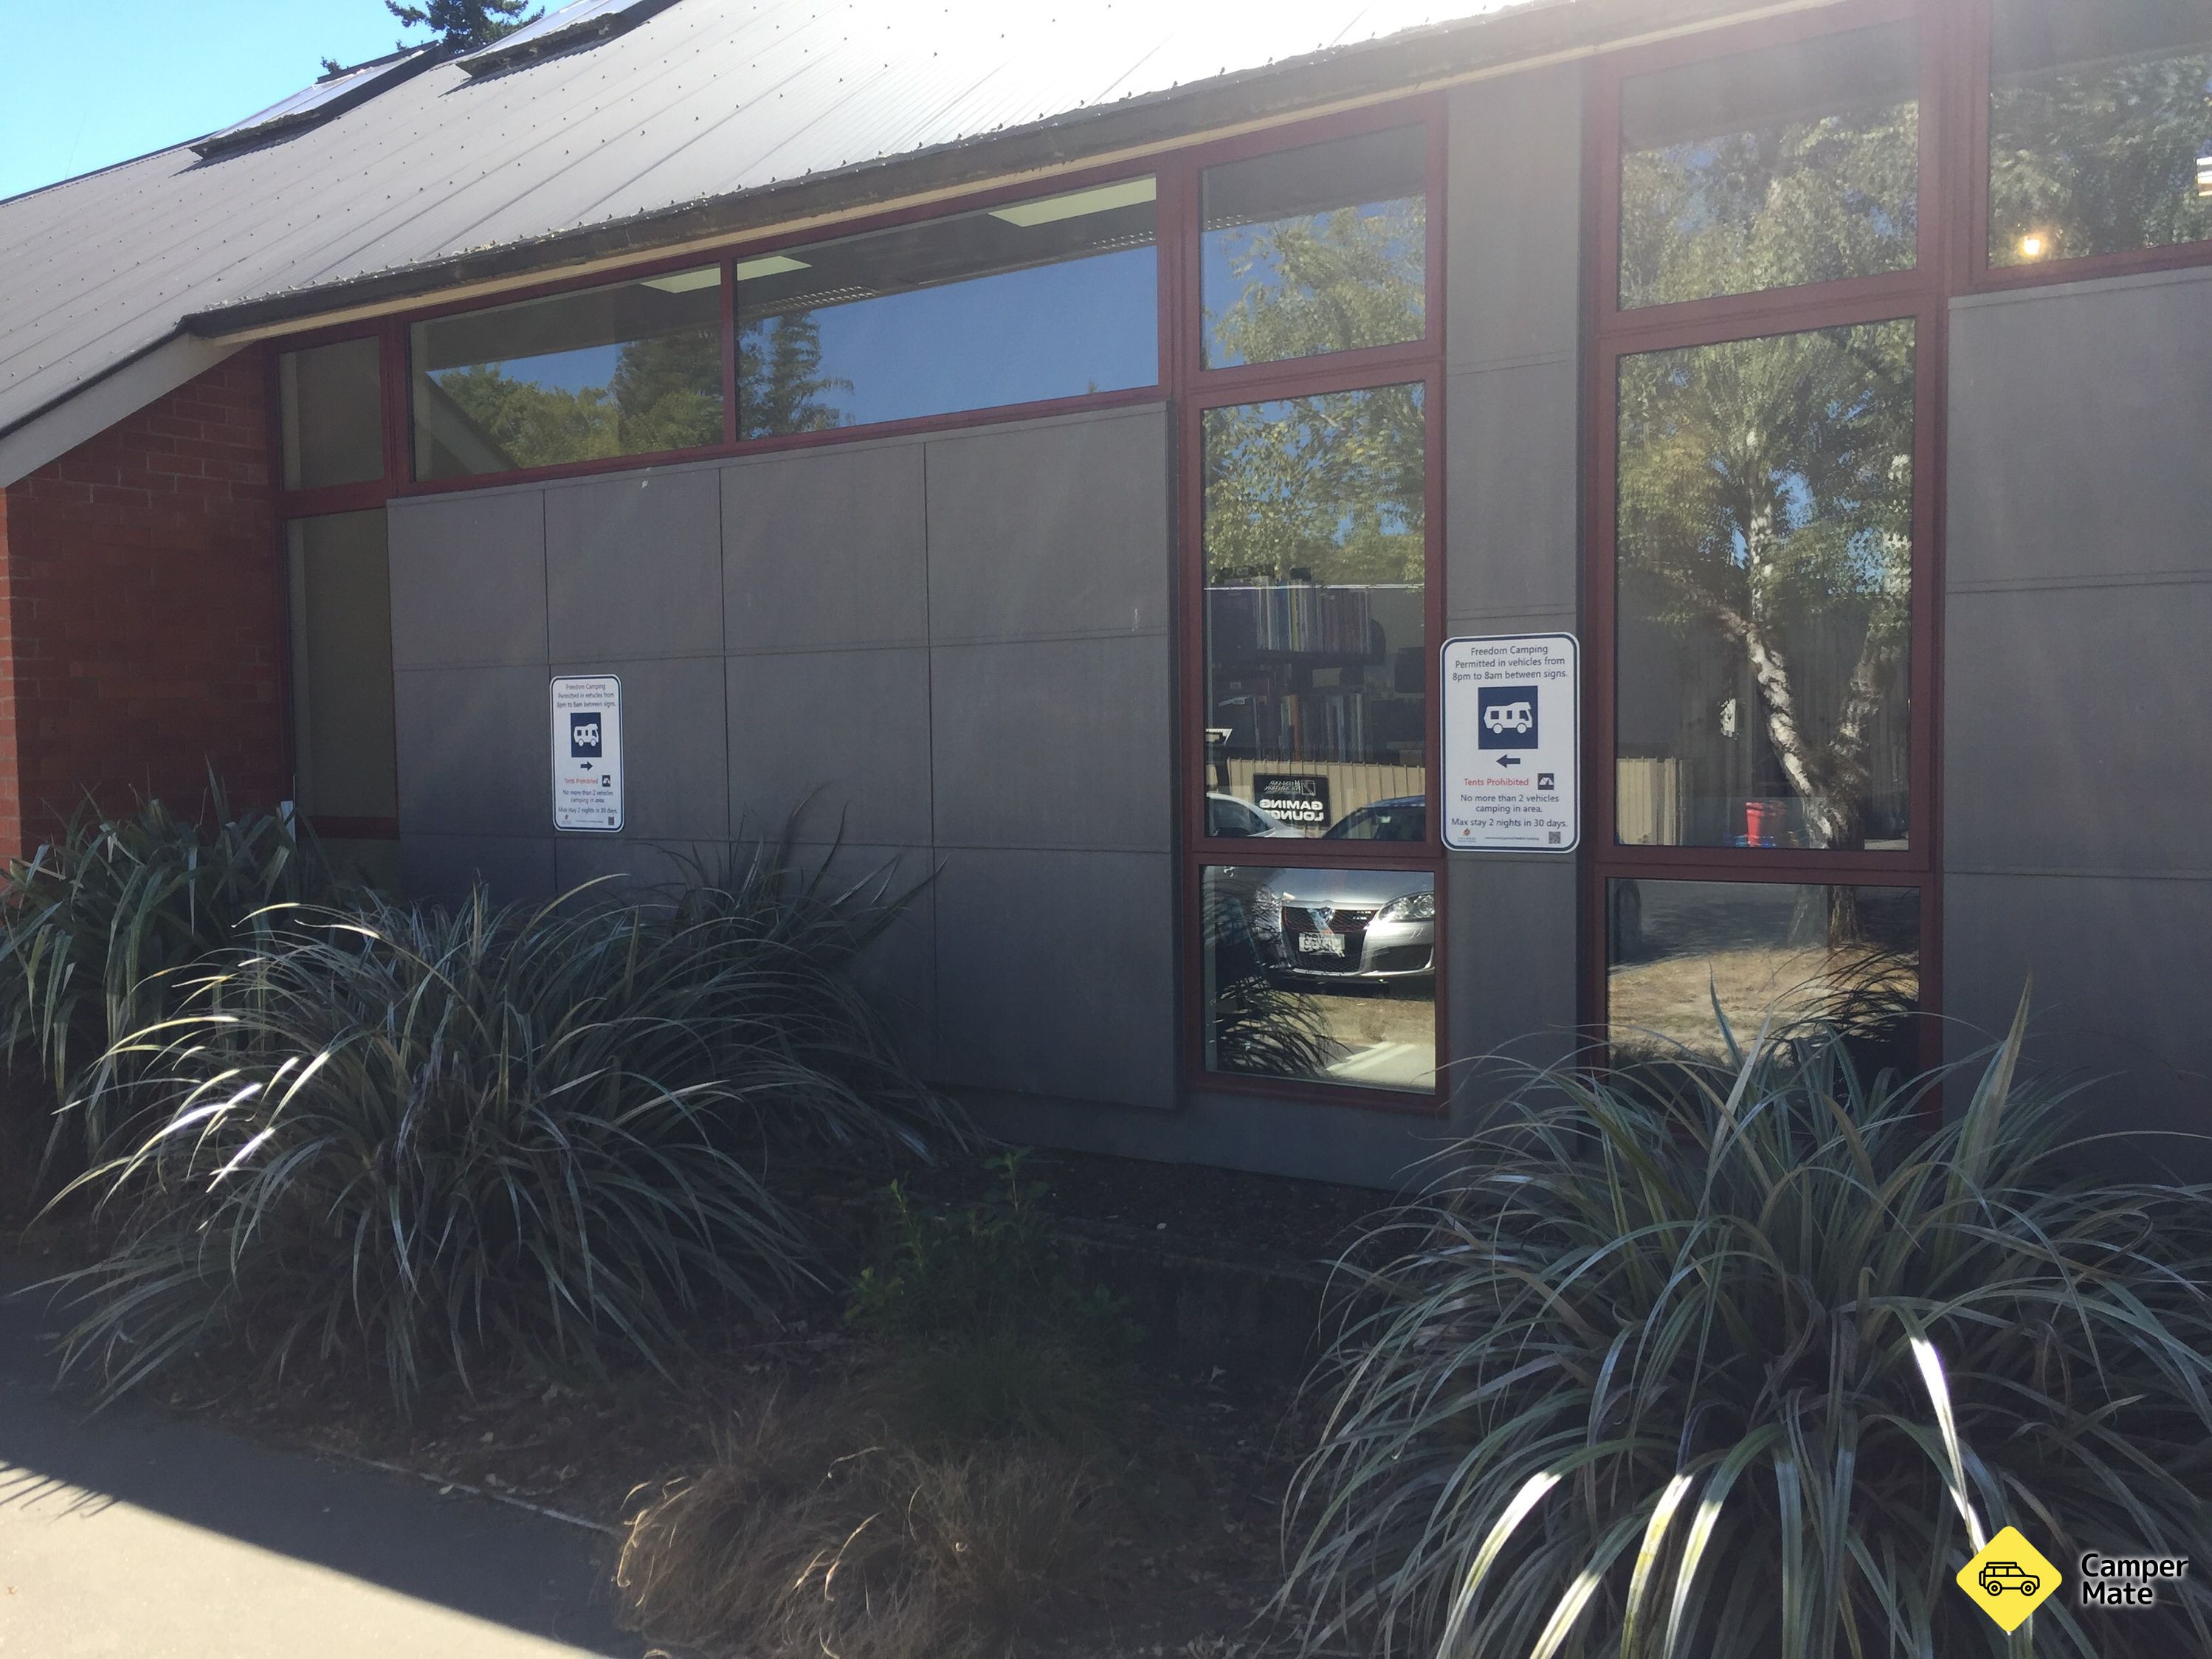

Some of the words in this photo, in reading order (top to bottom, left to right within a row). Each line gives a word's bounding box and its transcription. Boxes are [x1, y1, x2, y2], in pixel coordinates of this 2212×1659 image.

[1471, 646, 1507, 656] Freedom
[1510, 646, 1548, 655] Camping
[1455, 659, 1495, 668] Permitted
[1508, 658, 1541, 666] vehicles
[1545, 657, 1565, 665] from
[1453, 672, 1470, 682] 8pm
[1505, 671, 1540, 679] between
[1476, 805, 1510, 814] camping
[1470, 818, 1486, 827] stay
[1496, 819, 1521, 828] nights
[1546, 819, 1568, 829] days.
